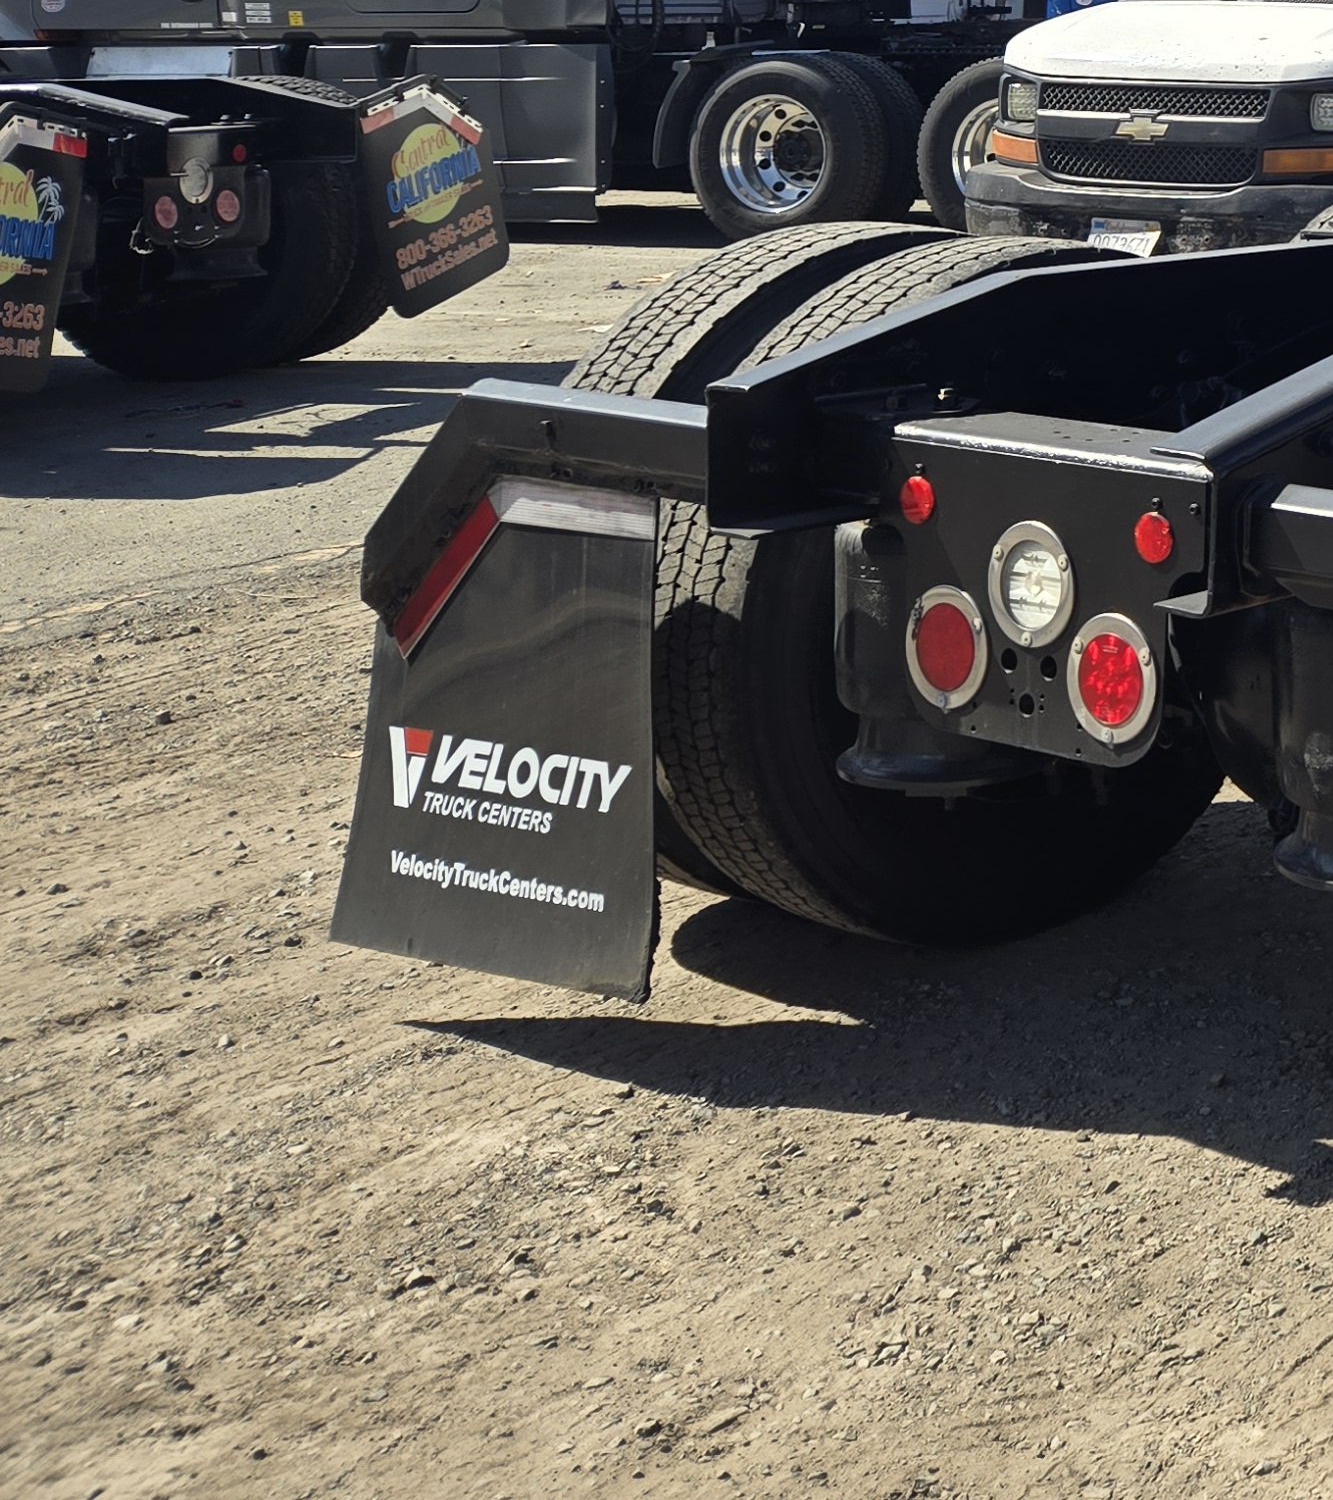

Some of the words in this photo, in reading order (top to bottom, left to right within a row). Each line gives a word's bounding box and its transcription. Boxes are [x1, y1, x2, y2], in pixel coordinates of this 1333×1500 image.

[385, 145, 482, 214] CALIFORNIA
[395, 205, 494, 270] 800-366-3263
[430, 734, 633, 814] VELOCITY
[421, 791, 475, 821] TRUCK
[477, 797, 553, 835] CENTERS
[390, 849, 605, 913] VelocityTruckCenters.com
